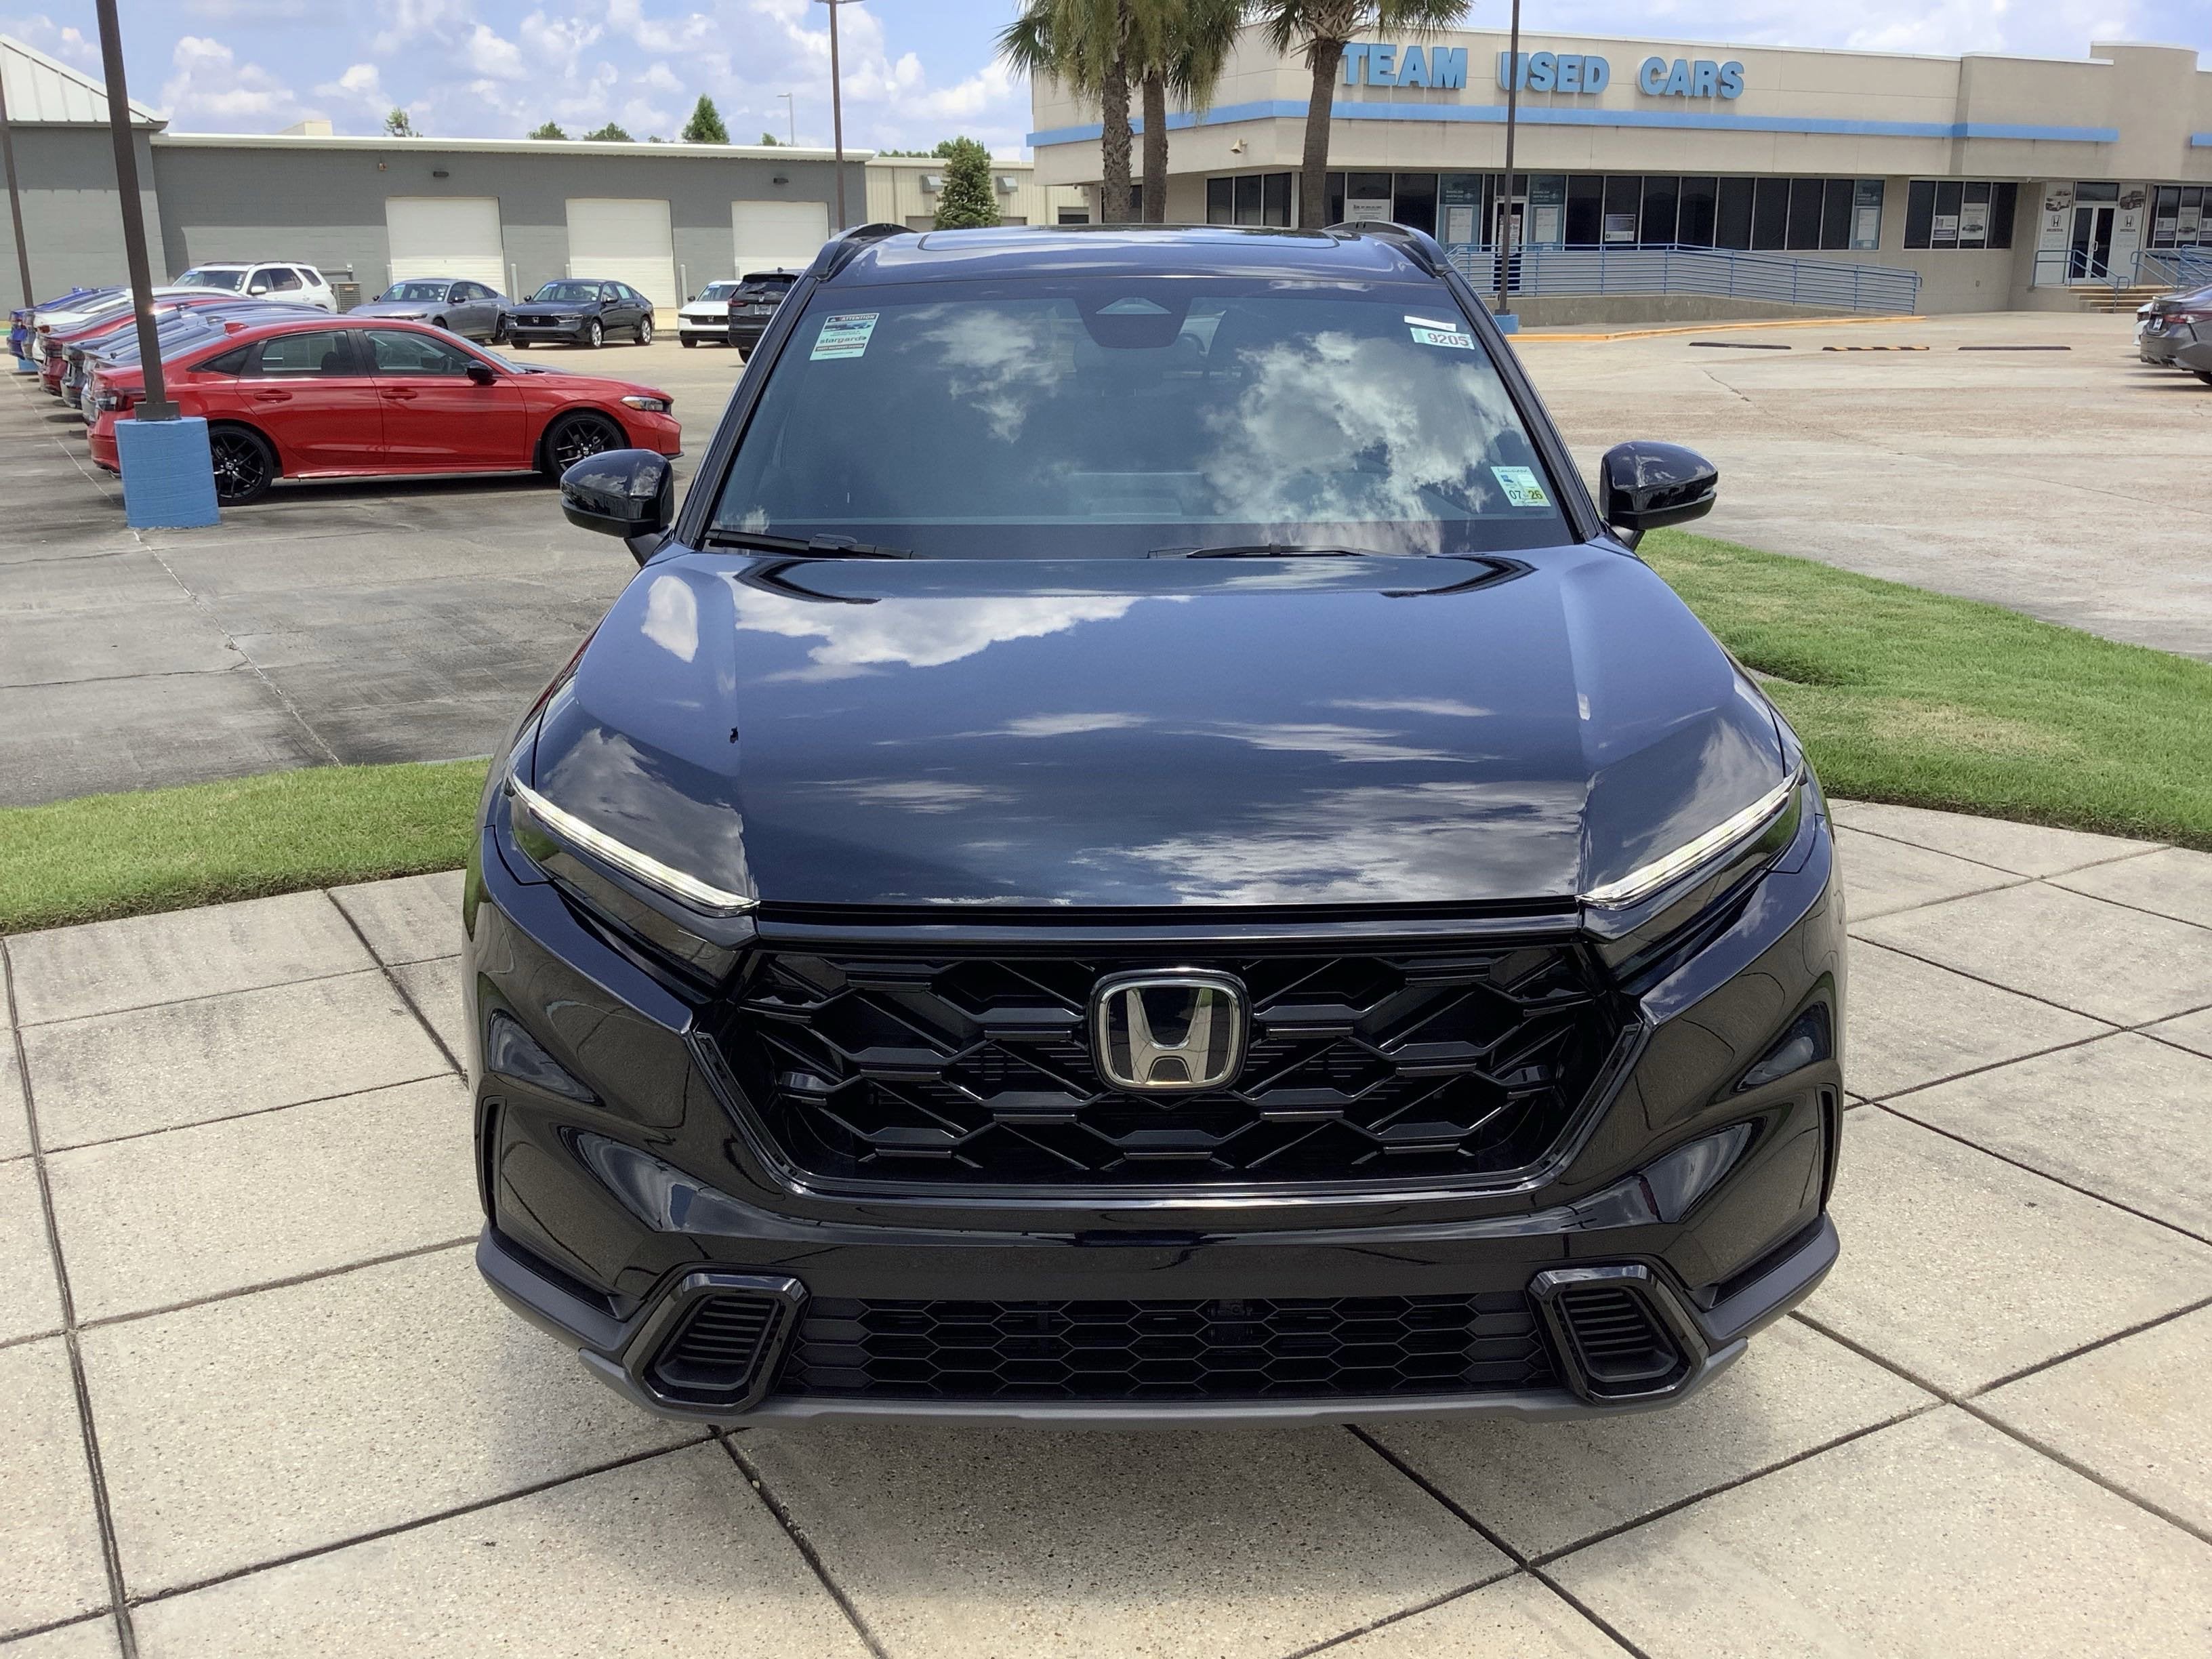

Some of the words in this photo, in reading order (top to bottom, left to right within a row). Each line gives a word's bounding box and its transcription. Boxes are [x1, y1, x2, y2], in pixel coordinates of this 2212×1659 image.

[1341, 43, 1468, 89] TEAM
[1499, 52, 1610, 94] USED
[1639, 57, 1744, 99] CARS
[1427, 333, 1469, 346] 9205
[1509, 490, 1521, 499] 07
[1528, 490, 1543, 499] 26
